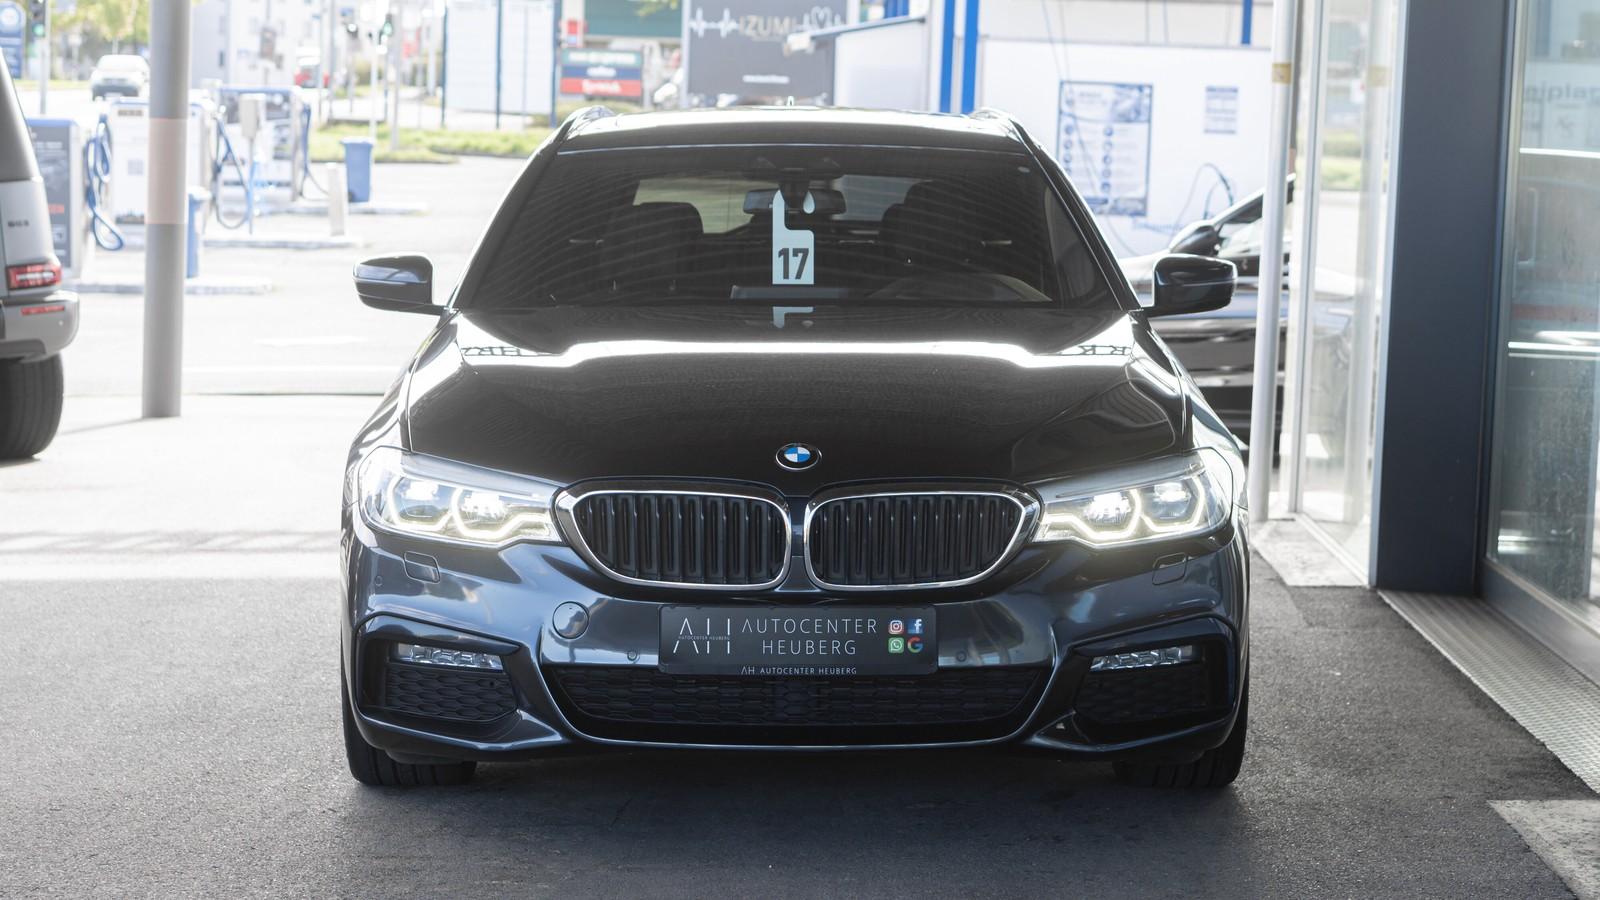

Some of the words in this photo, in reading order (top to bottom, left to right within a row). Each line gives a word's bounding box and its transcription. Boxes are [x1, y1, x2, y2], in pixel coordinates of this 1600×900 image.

[778, 247, 810, 280] 17
[741, 618, 877, 634] AUTOCENTER
[762, 639, 857, 655] HEUBERG
[740, 666, 755, 675] AH
[760, 667, 815, 675] AUTOCENTER
[818, 667, 857, 675] HEUBERG
